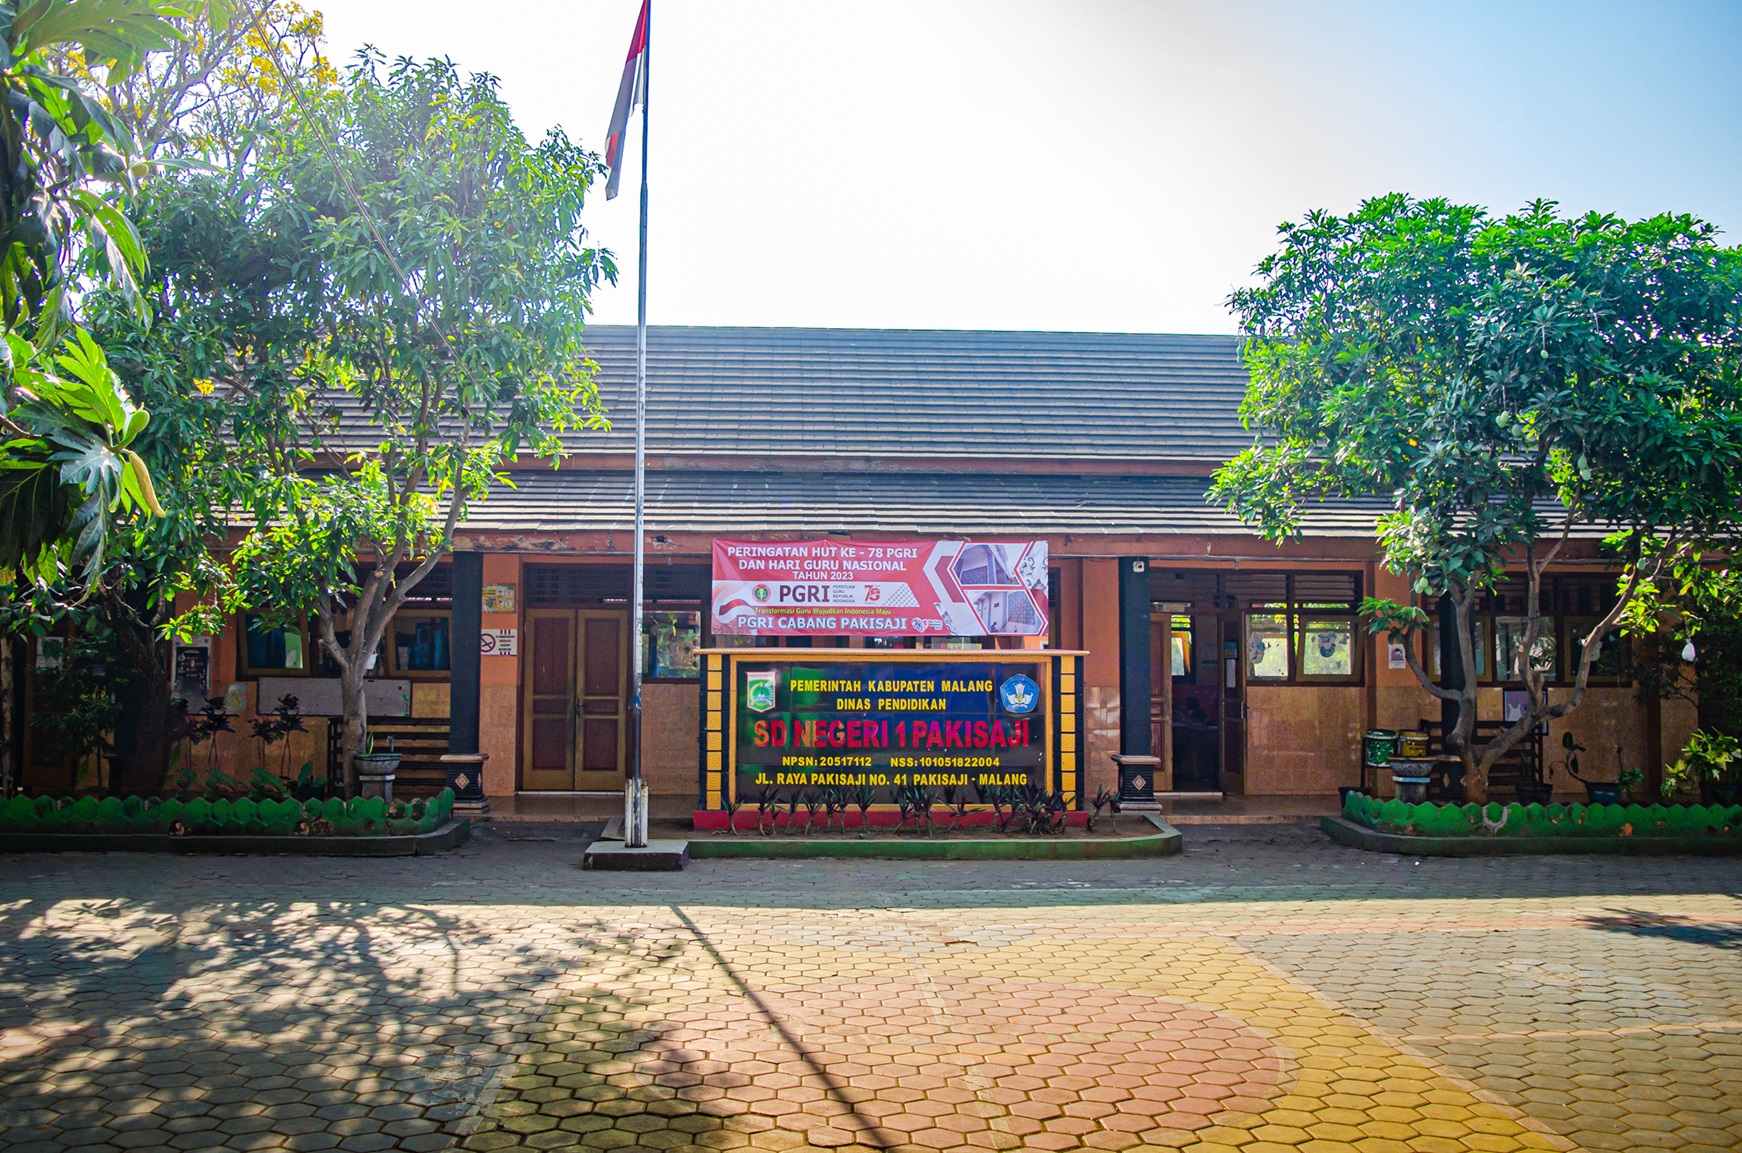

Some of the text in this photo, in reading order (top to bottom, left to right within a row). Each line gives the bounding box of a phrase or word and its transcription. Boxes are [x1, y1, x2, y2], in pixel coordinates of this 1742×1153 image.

[727, 546, 808, 557] PERINGATAN
[811, 547, 837, 557] HUT
[840, 547, 856, 557] KE
[868, 548, 883, 558] 78
[886, 548, 918, 558] PGRI
[738, 560, 907, 571] DAN HARI GURU NASIONAL
[792, 571, 853, 580] TAHUN 2023
[779, 584, 830, 603] PGRI
[813, 607, 843, 615] Wujudkan
[876, 608, 891, 616] Maju
[738, 616, 908, 630] PGRI CABANG PAKISAJI
[790, 680, 993, 692] PEMERINTAH KABUPATEN MALANG
[836, 698, 947, 711] DINAS PENDIDIKAN
[753, 719, 1029, 748] SD NEGERI 1 PAKISAJI
[755, 772, 773, 785] JL.
[777, 773, 808, 785] RAYA
[811, 773, 866, 786] PAKISAJI
[869, 774, 890, 786] NO.
[893, 774, 907, 786] 41
[913, 774, 968, 786] PAKISAJI
[979, 773, 1027, 785] MALANG
